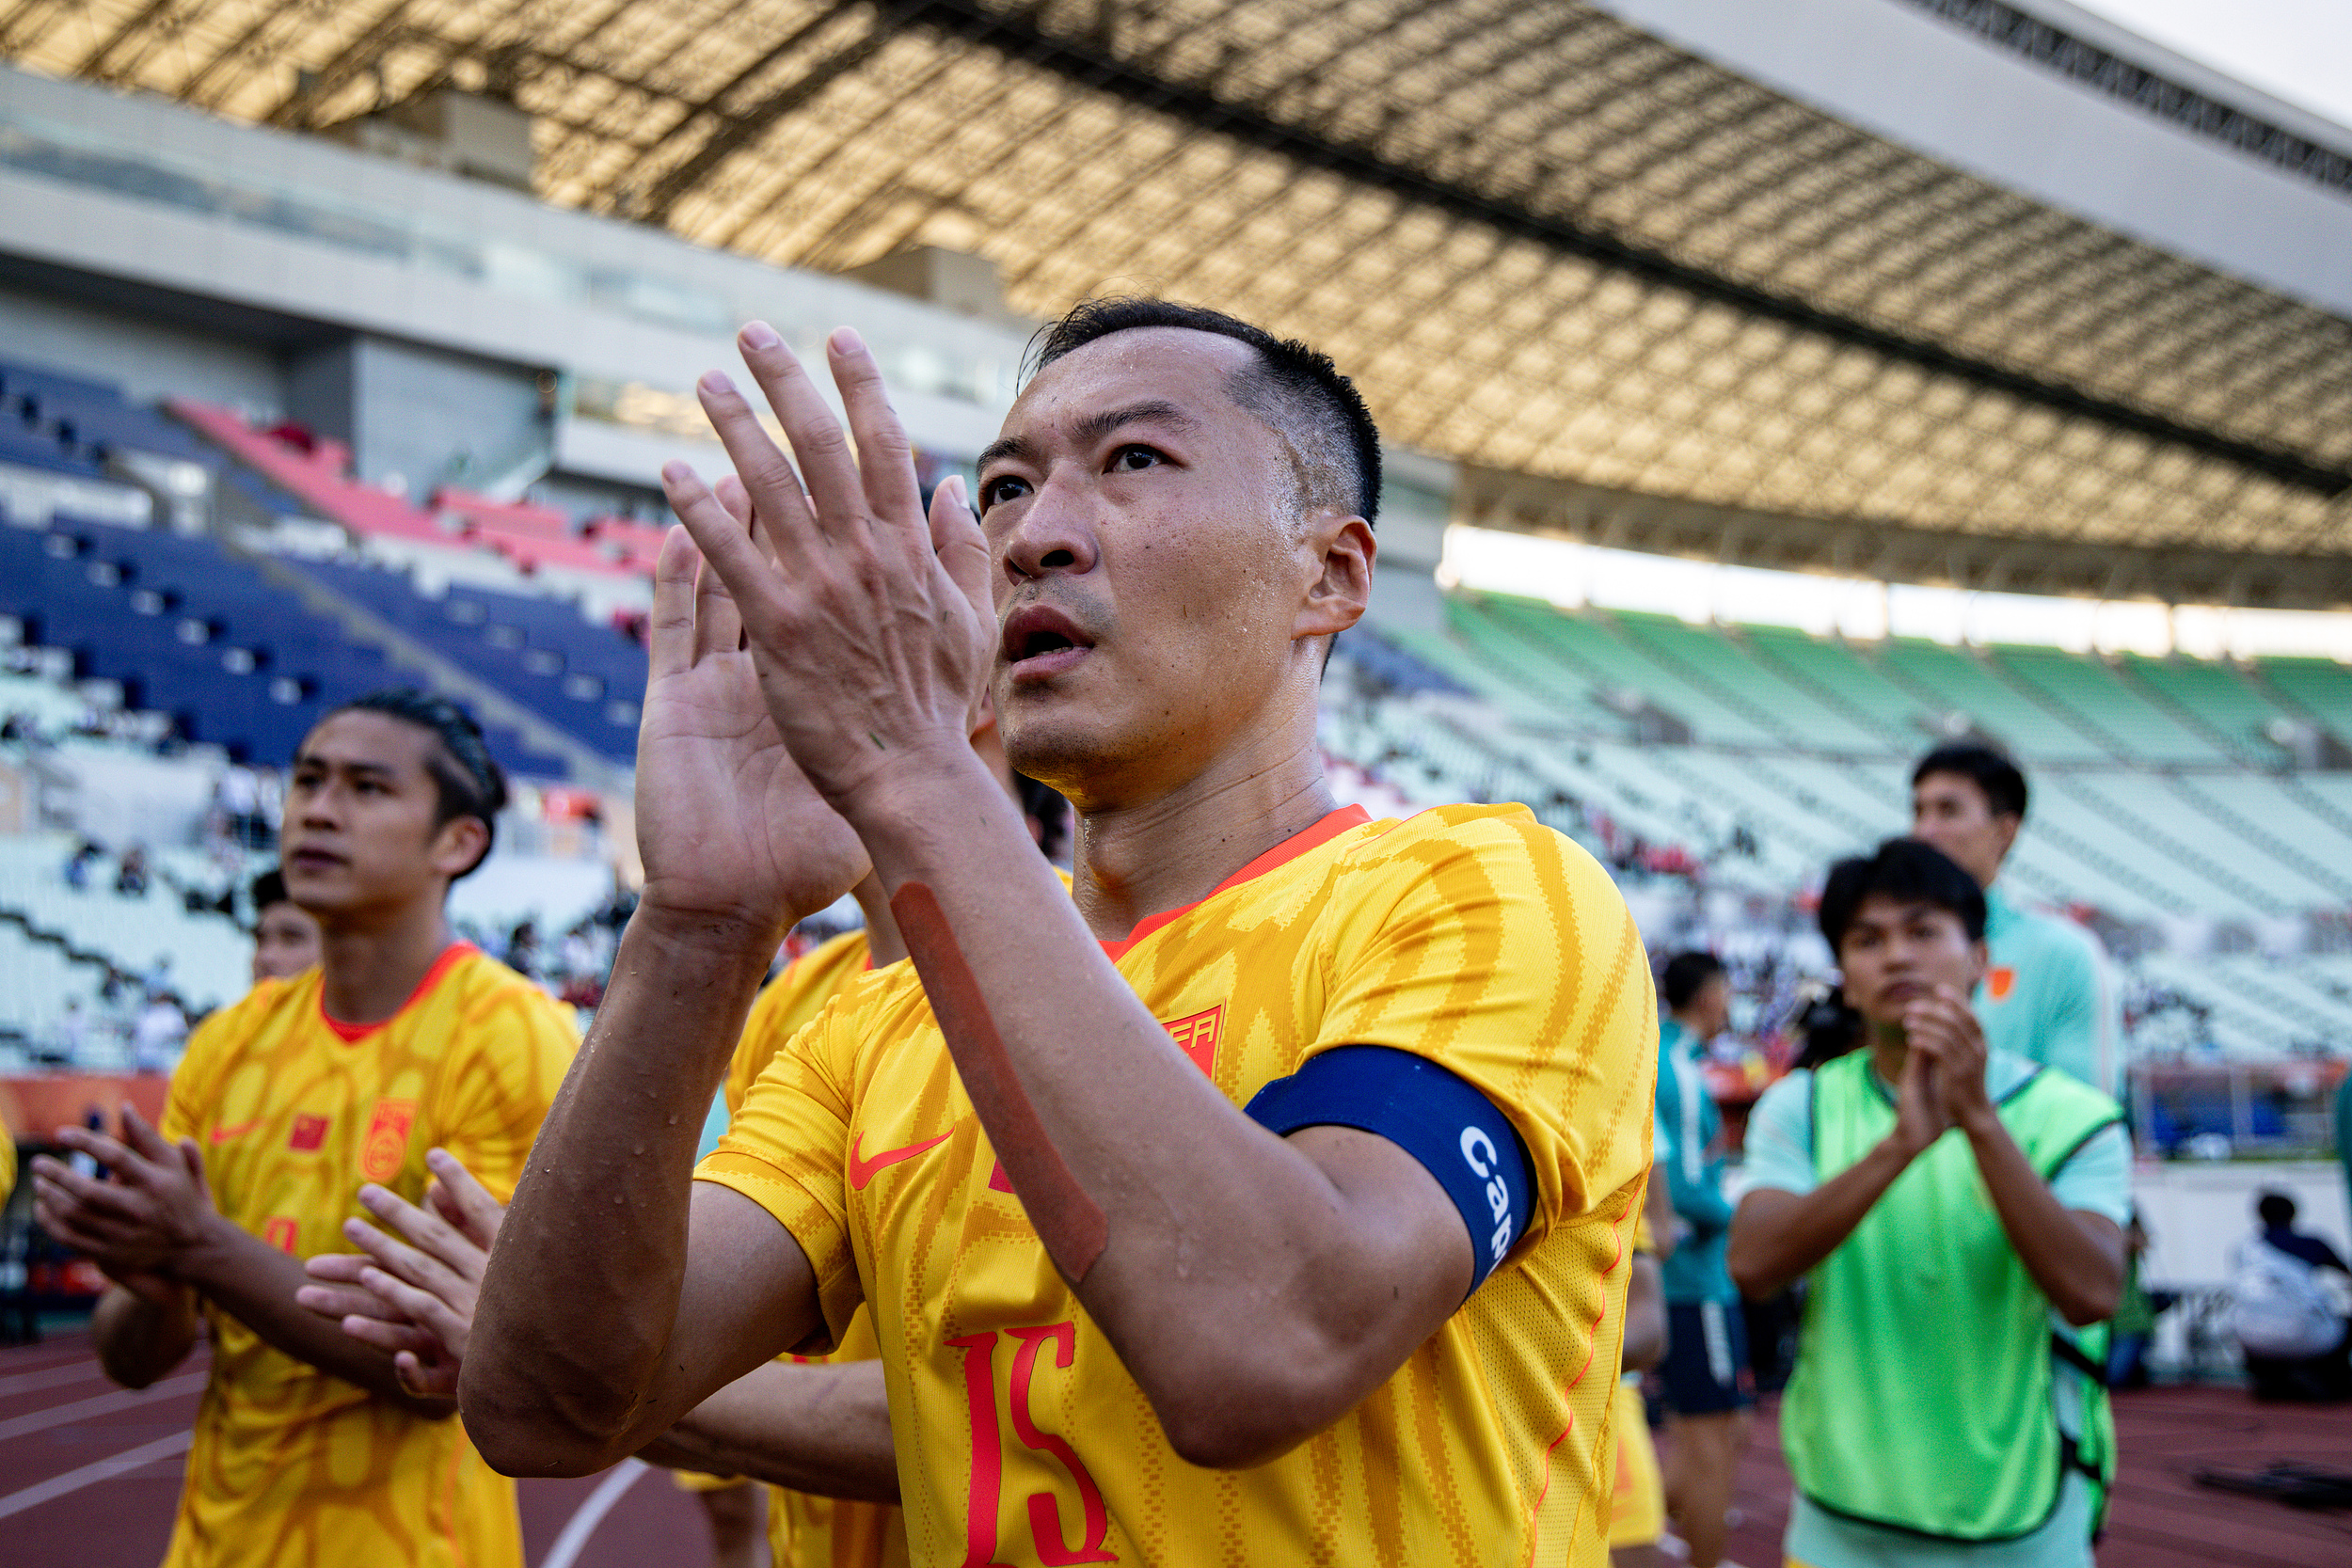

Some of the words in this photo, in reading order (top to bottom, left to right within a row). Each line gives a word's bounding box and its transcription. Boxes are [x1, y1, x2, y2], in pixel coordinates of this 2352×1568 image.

[1168, 1013, 1217, 1049] FA
[1460, 1126, 1512, 1276] Cap
[943, 1321, 1120, 1568] 15
